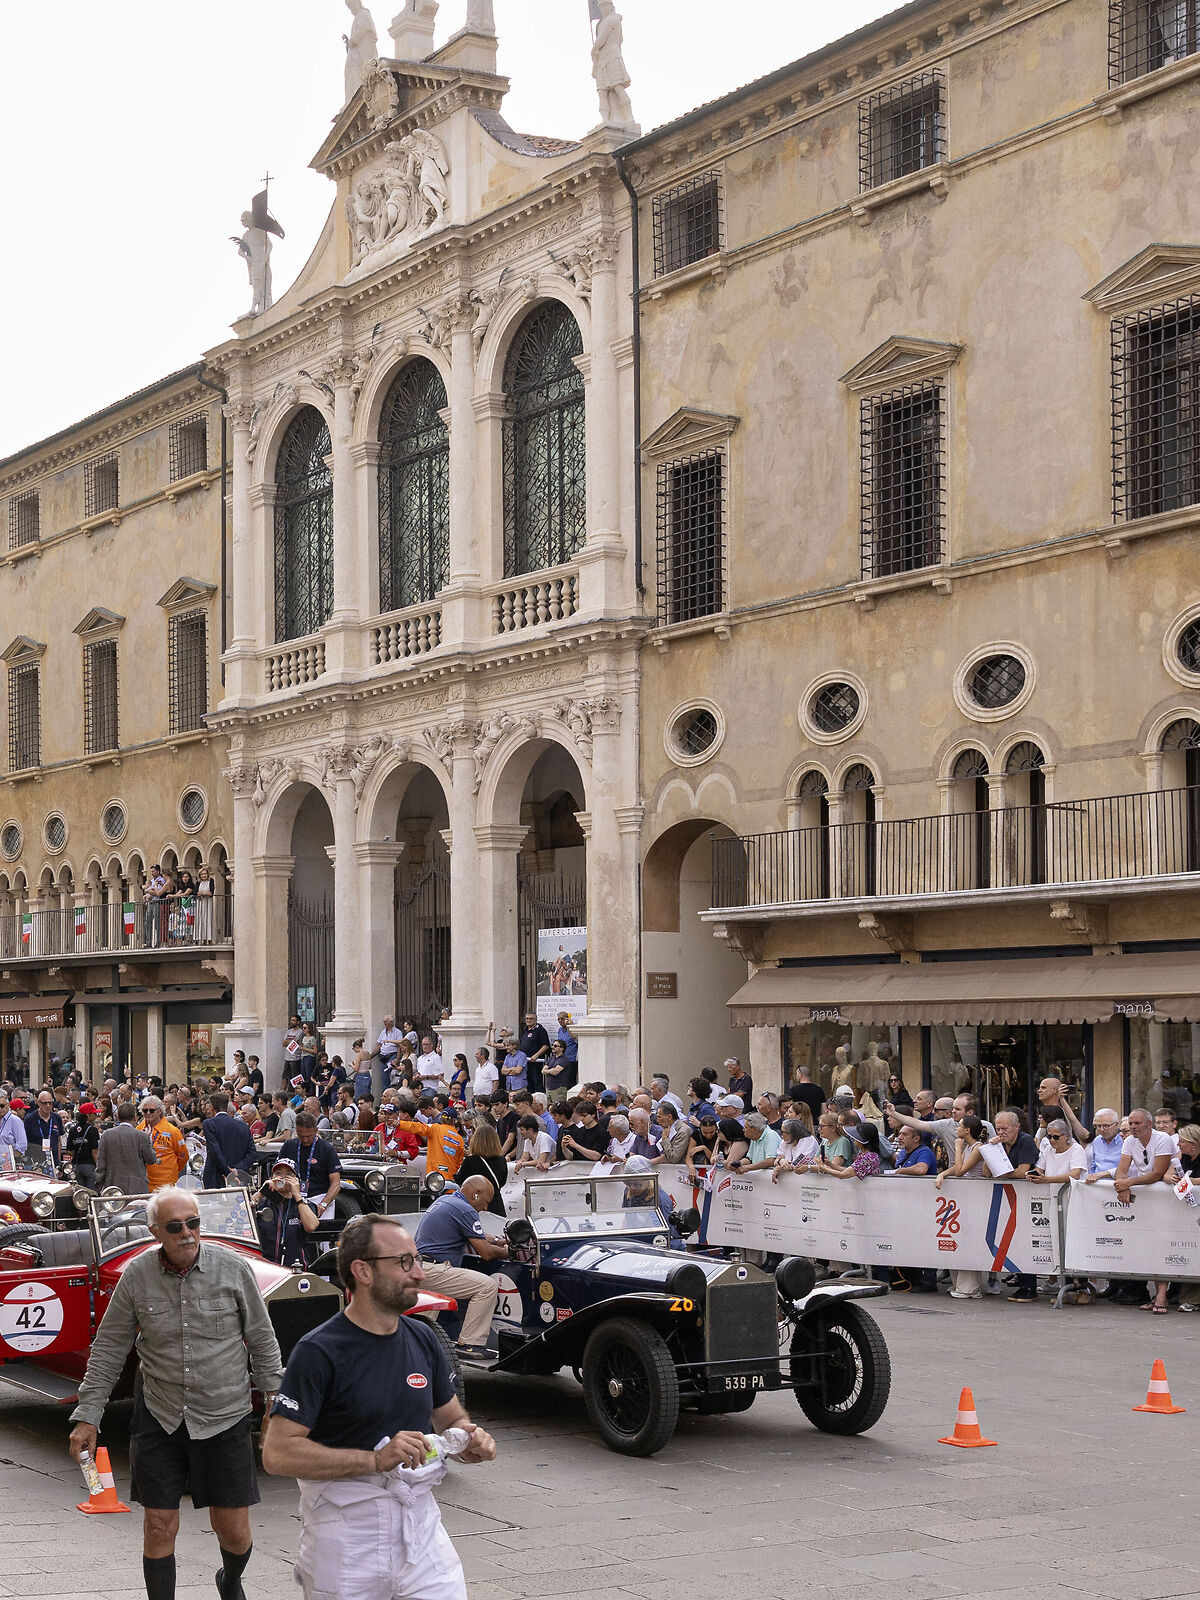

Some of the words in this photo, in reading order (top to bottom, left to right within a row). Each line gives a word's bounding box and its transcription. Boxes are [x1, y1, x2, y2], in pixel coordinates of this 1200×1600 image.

[539, 928, 587, 936] SUPERLIGHT
[1116, 1000, 1154, 1014] nanà
[494, 1296, 511, 1317] 26
[670, 1297, 694, 1312] 26
[16, 1306, 46, 1328] 42
[726, 1376, 747, 1390] 539
[752, 1375, 765, 1389] PA
